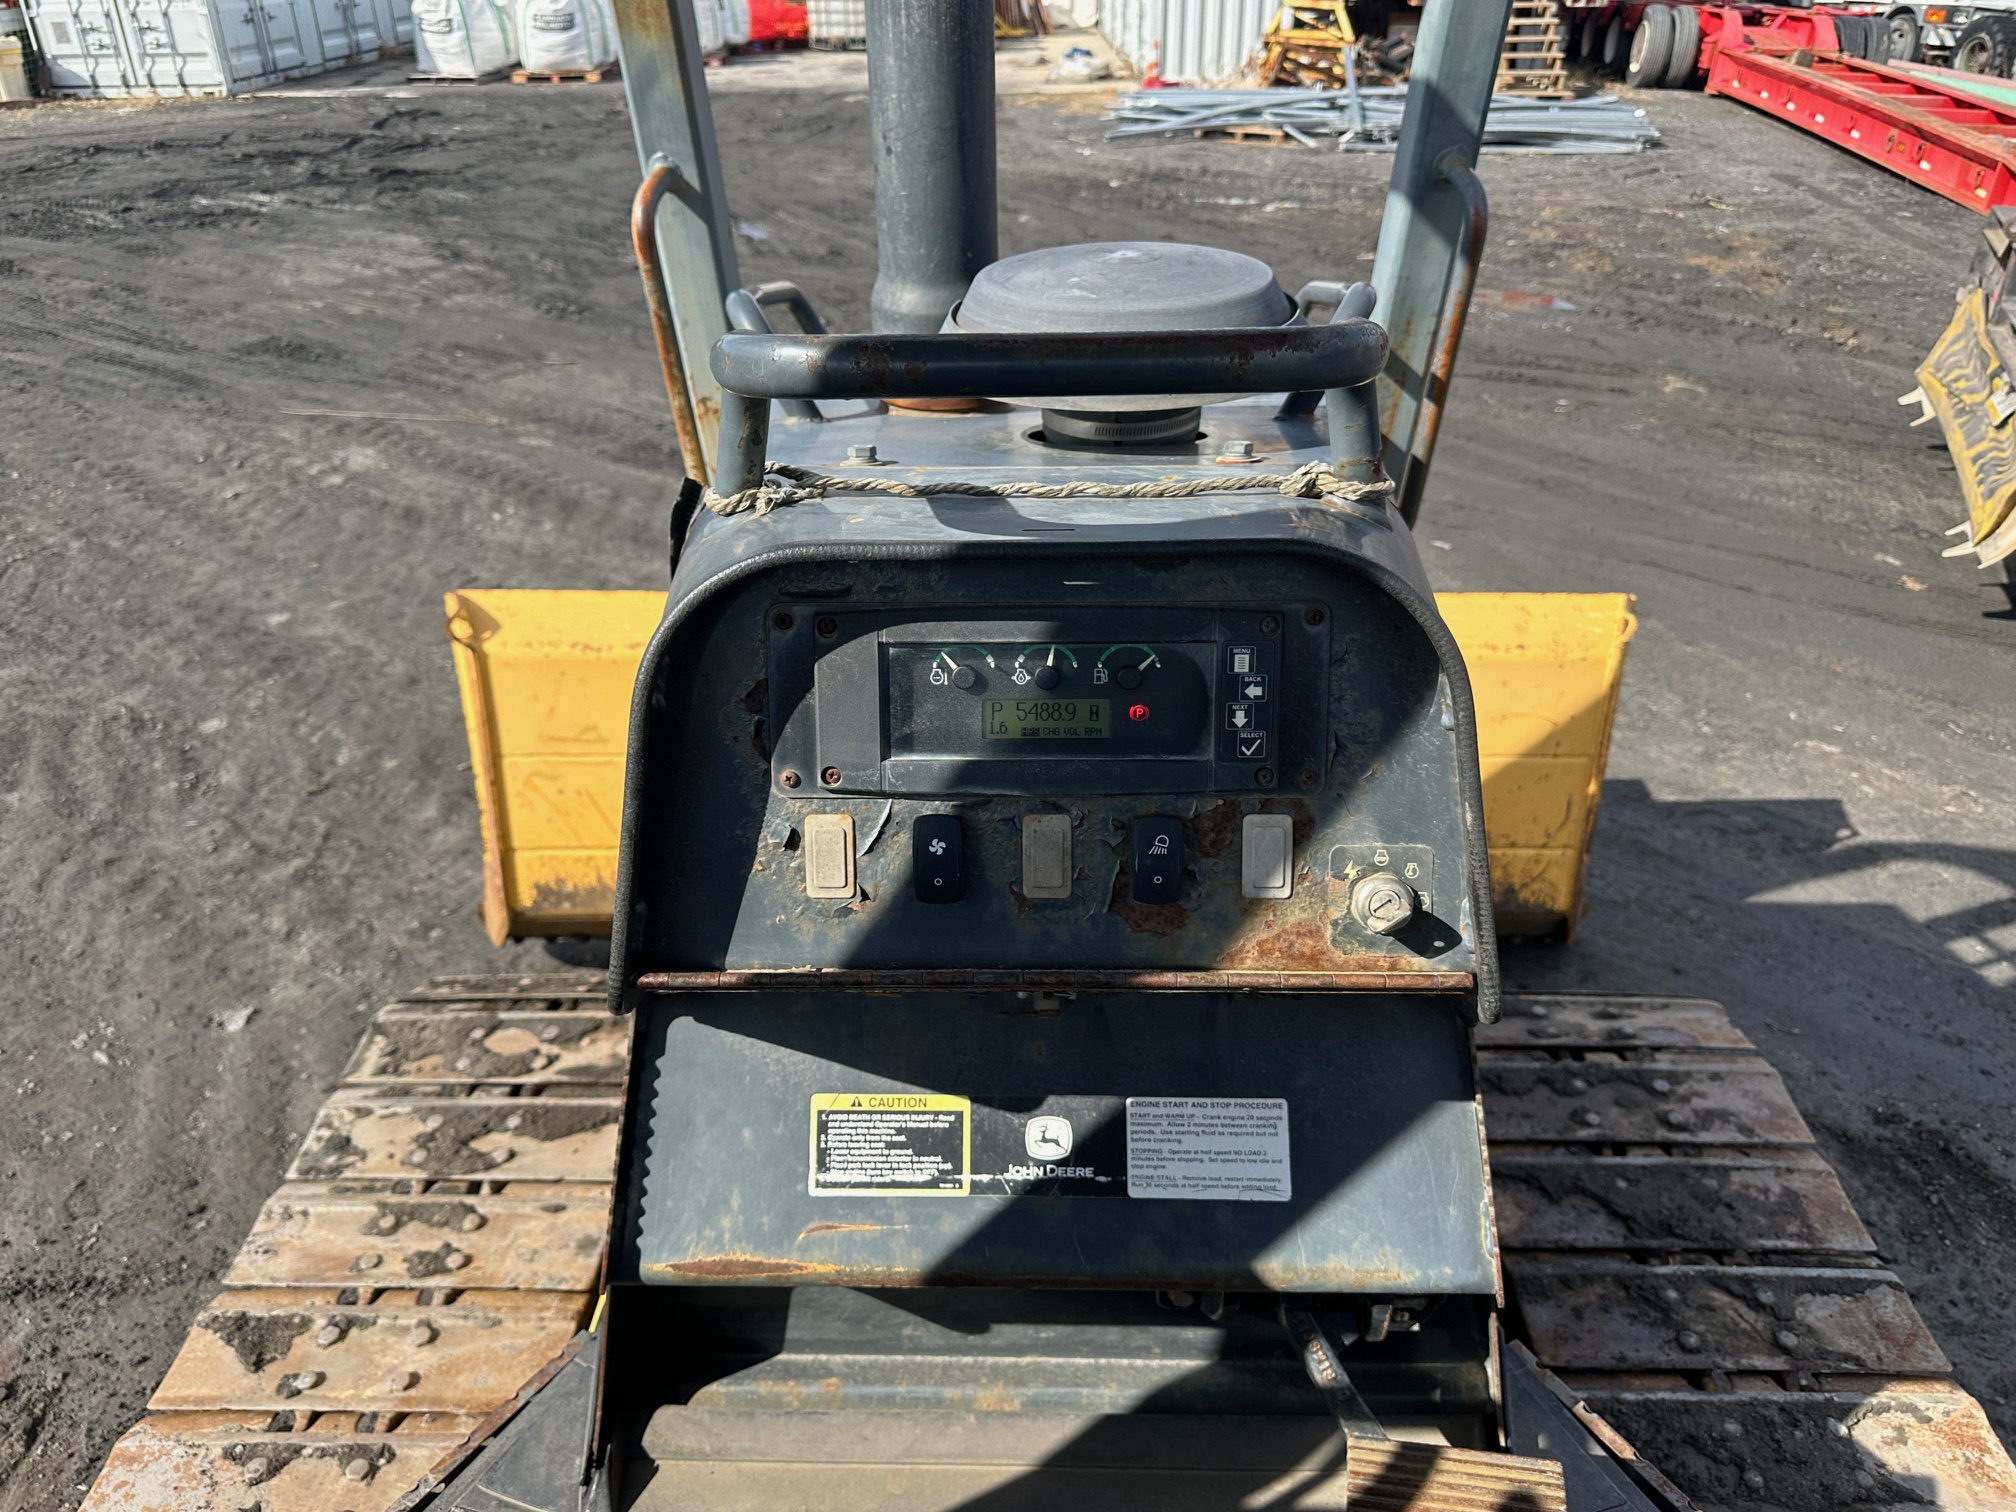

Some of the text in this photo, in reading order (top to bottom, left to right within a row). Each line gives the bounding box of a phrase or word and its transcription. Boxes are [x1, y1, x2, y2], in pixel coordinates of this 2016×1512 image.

[992, 702, 1076, 721] P 5488.9
[990, 721, 1102, 736] 1.6 HRS CHG VOL RPM
[868, 1097, 927, 1108] CAUTION
[1210, 1101, 1231, 1109] STOP
[1249, 1122, 1277, 1130] cranking
[1003, 1164, 1094, 1178] JOHN DEERE
